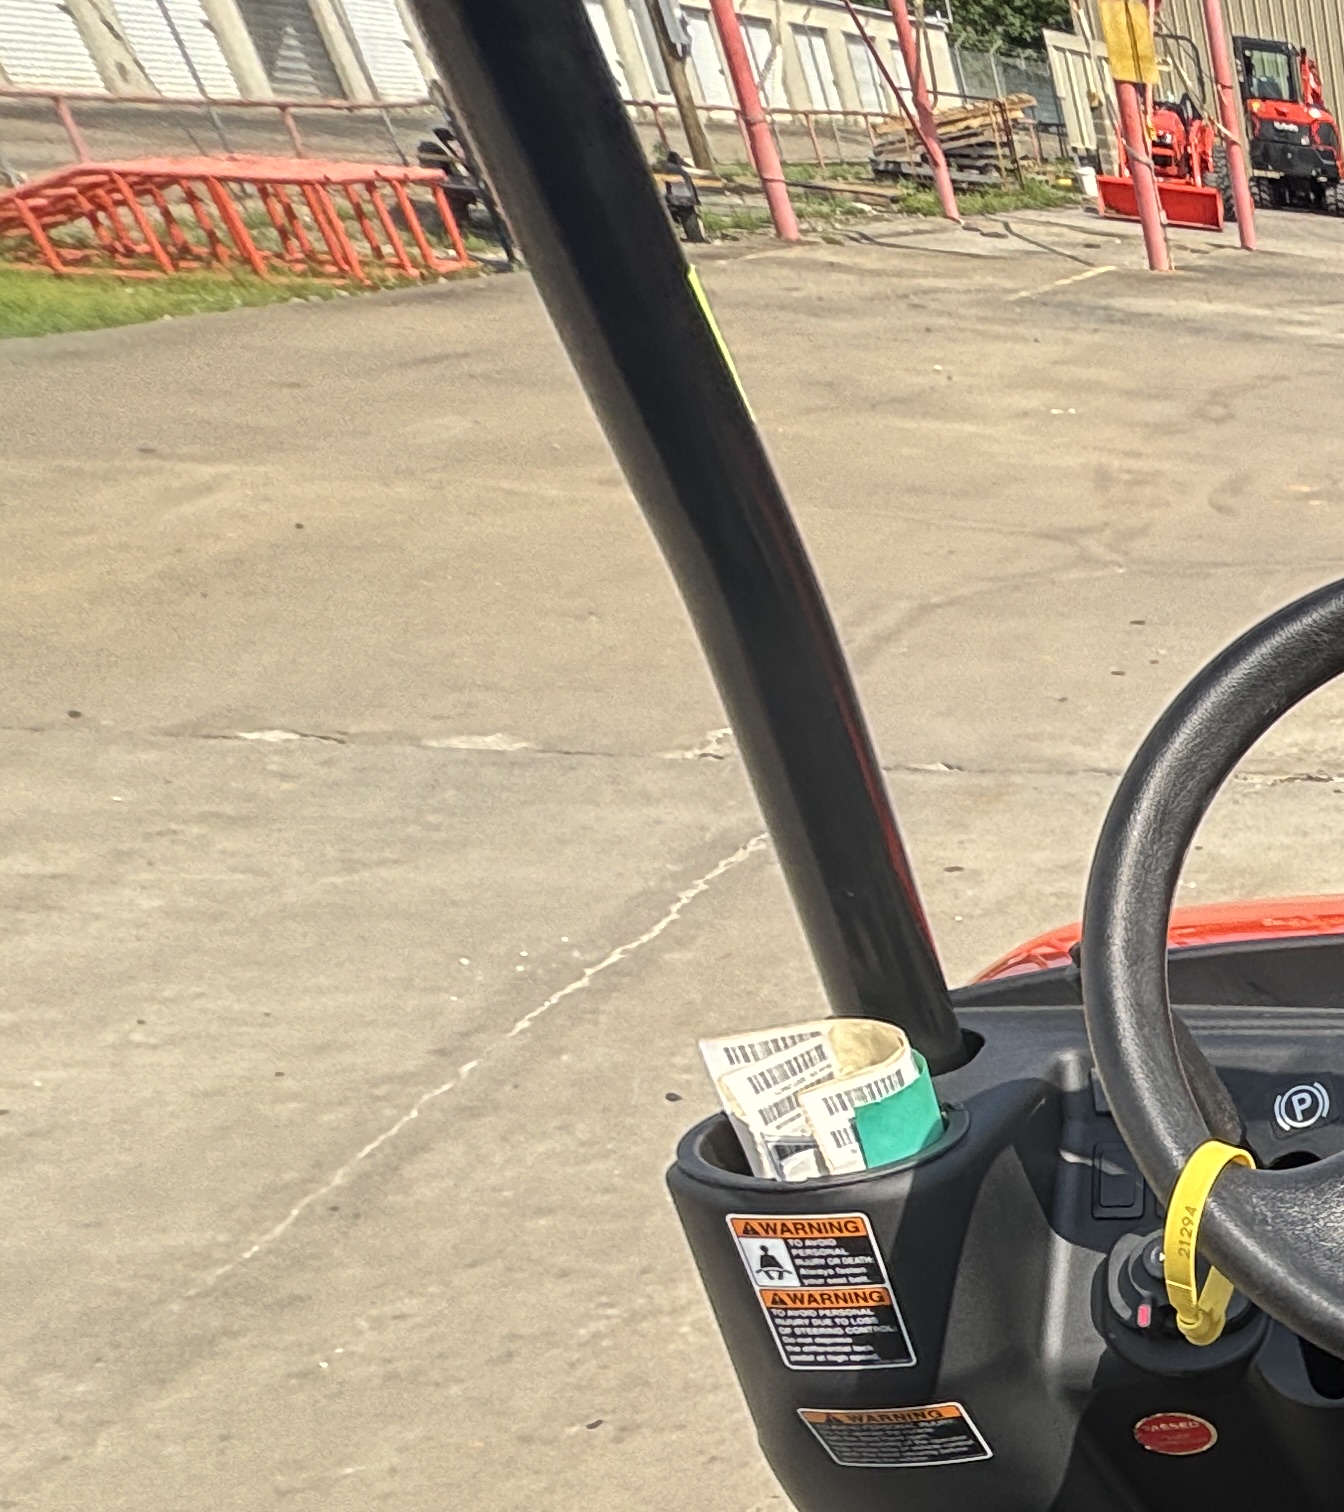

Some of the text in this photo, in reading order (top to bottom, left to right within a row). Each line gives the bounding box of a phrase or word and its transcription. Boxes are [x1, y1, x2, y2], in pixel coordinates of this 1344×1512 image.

[757, 1220, 860, 1235] WARNING
[1177, 1205, 1198, 1260] 21294
[786, 1290, 884, 1306] WARNING
[845, 1409, 943, 1422] WARNING
